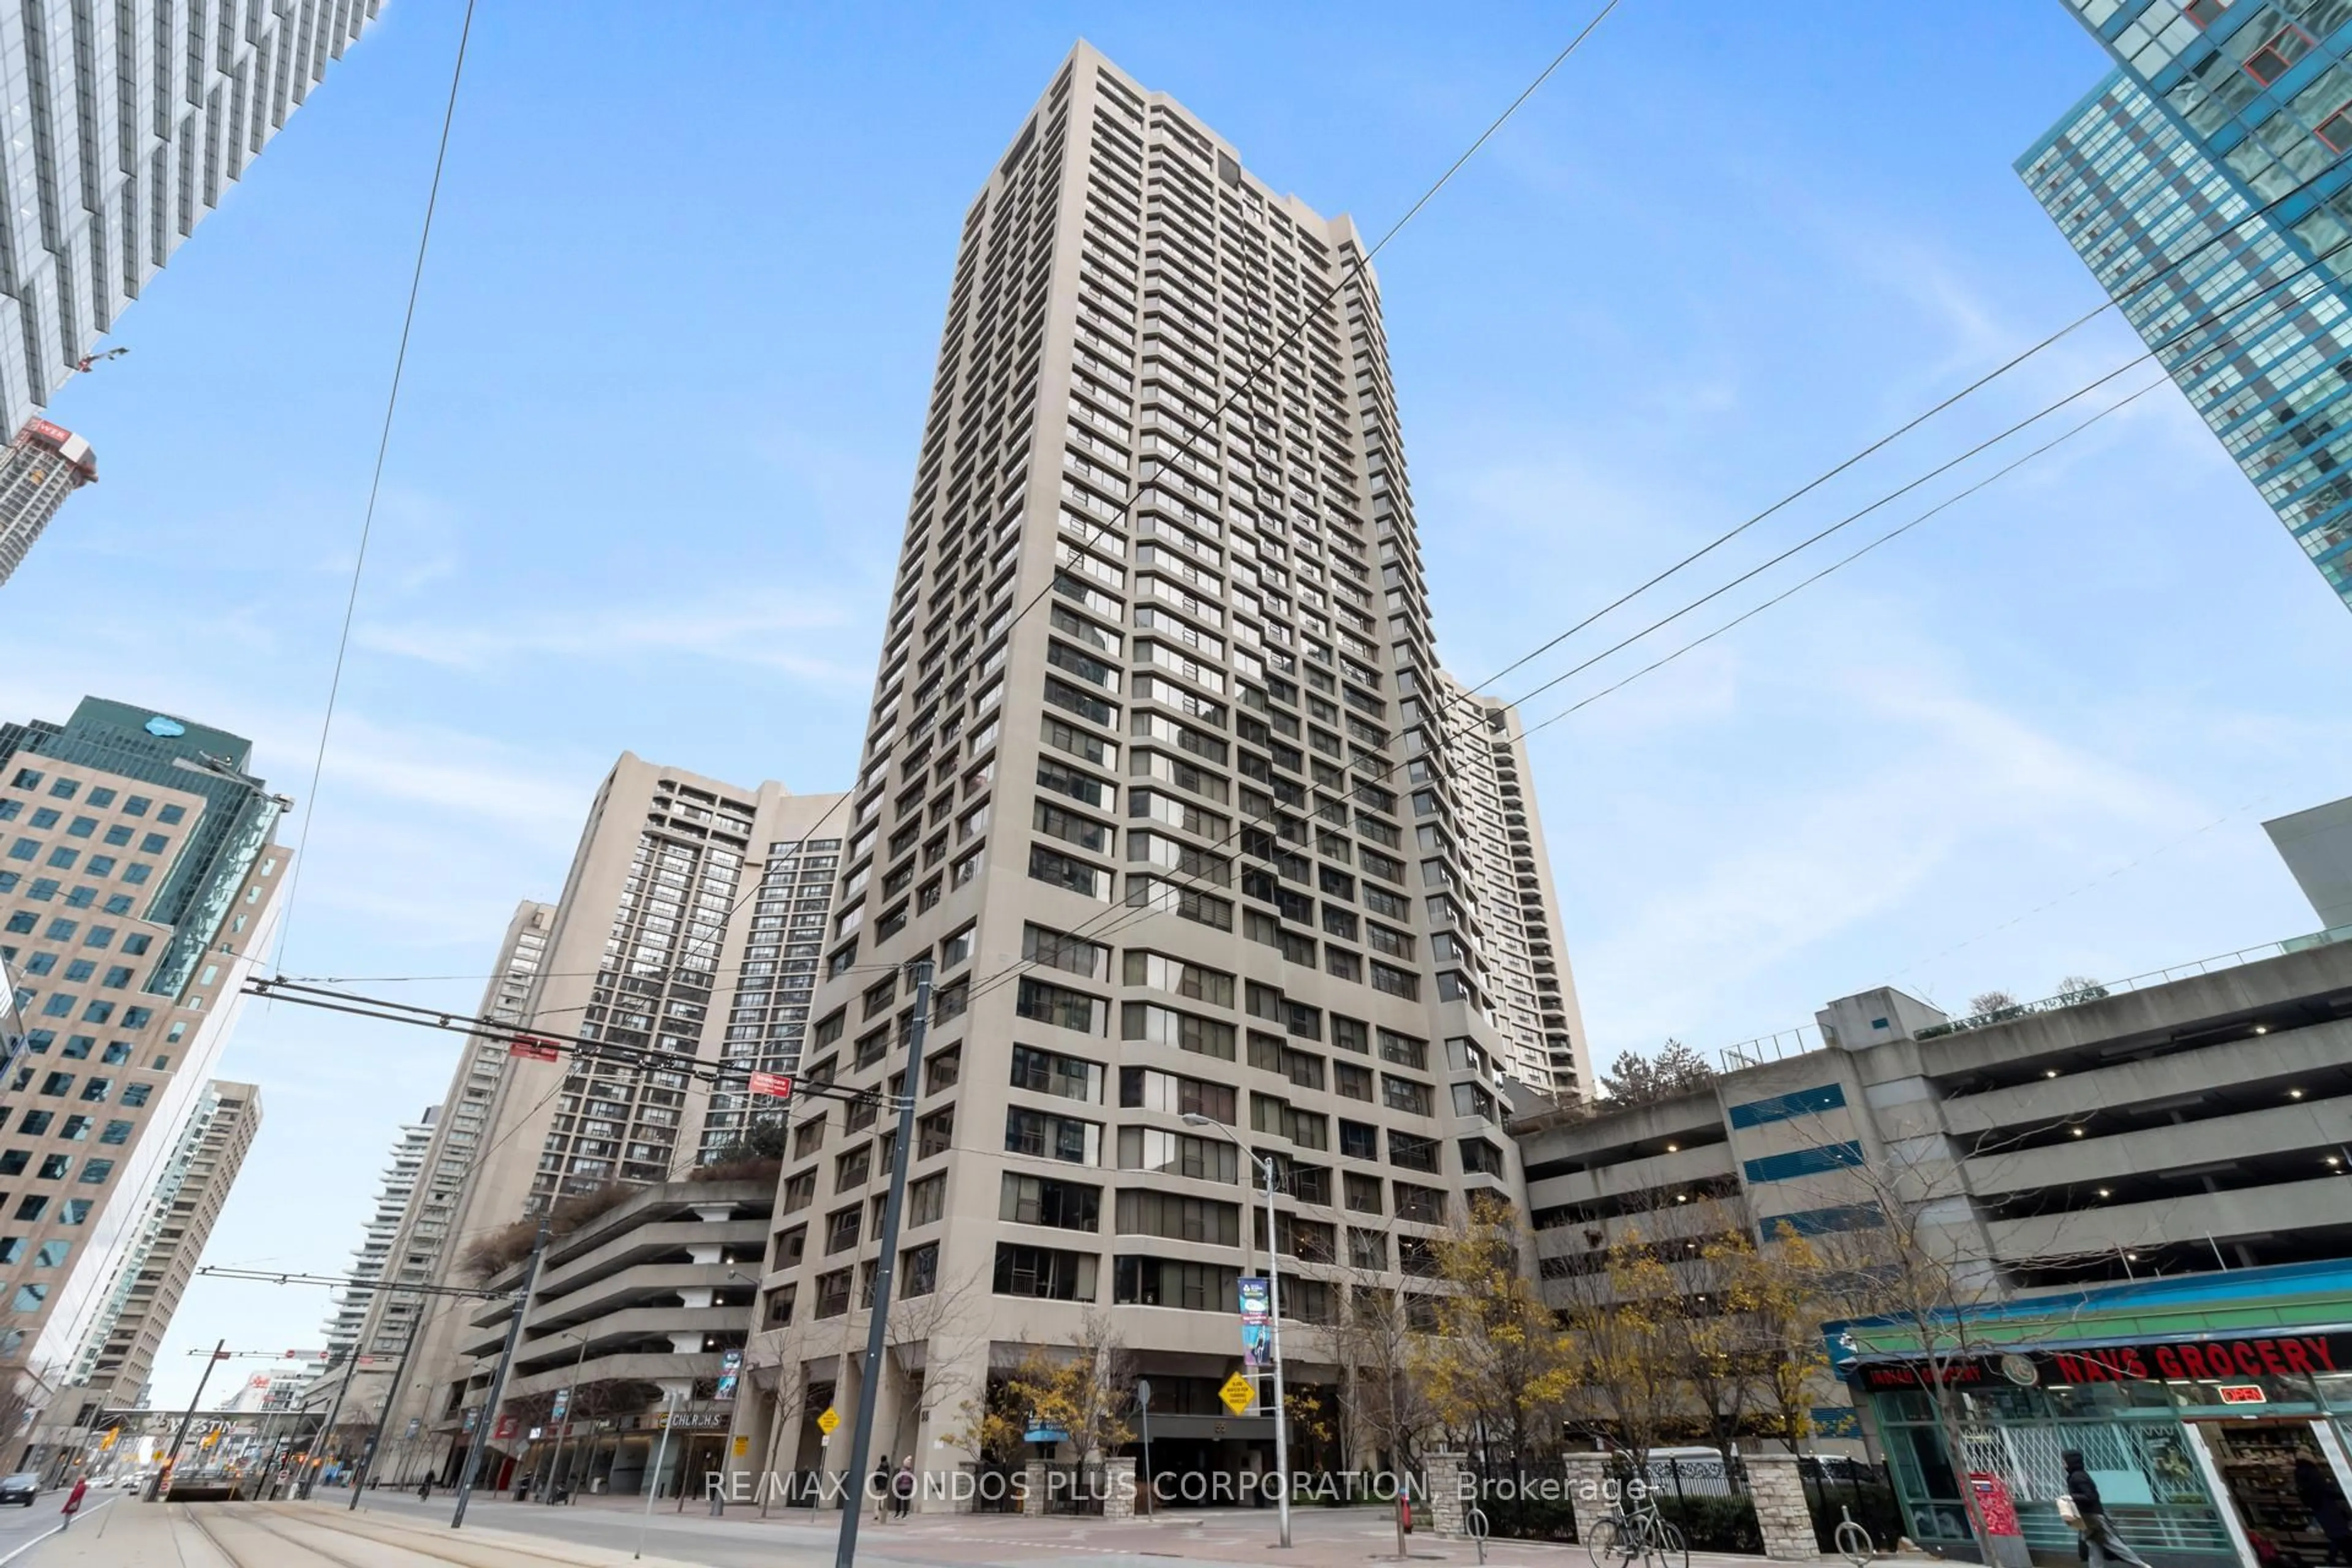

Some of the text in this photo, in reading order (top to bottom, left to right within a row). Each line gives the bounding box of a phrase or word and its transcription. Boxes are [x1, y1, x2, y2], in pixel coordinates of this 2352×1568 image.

[2055, 1347, 2147, 1384] NAVS
[2155, 1336, 2337, 1379] GROCERY
[1921, 1365, 1981, 1383] GOCERY
[2223, 1388, 2262, 1402] OPEN
